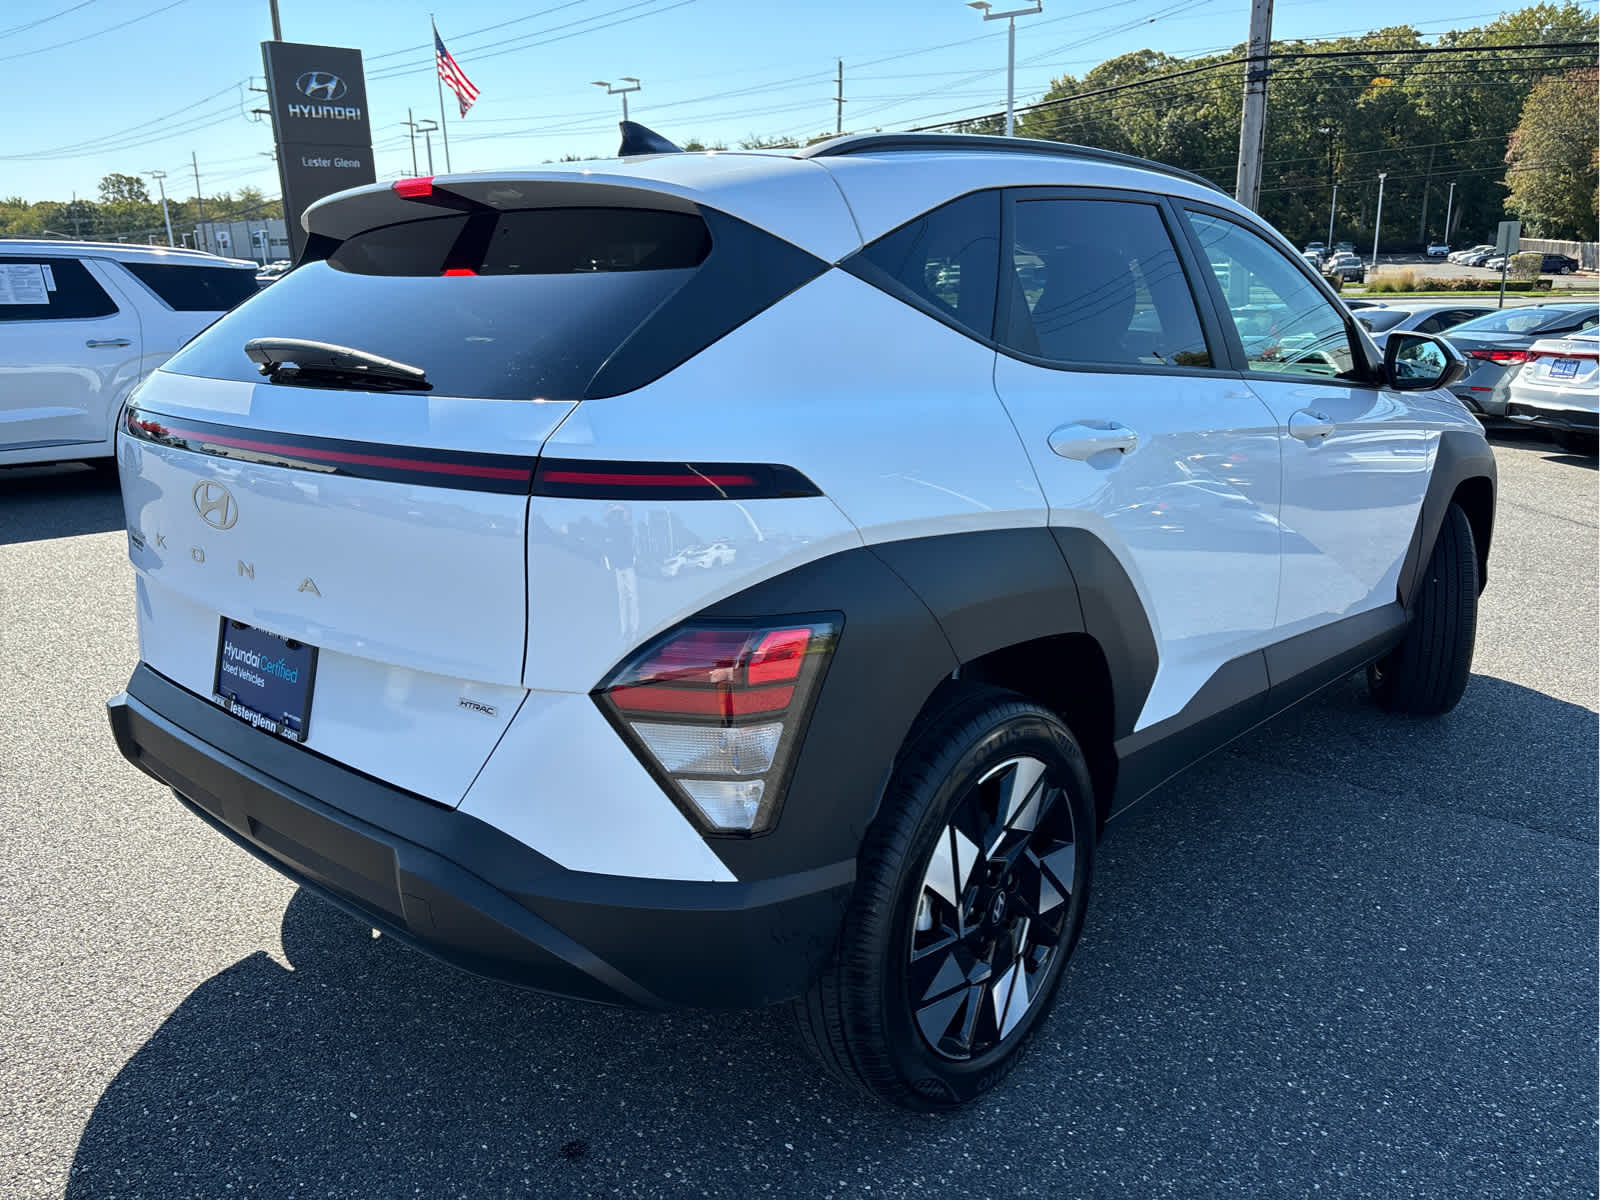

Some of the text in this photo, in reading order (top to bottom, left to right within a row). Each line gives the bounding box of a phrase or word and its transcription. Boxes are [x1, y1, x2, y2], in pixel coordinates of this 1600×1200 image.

[288, 103, 361, 120] HYUNDAI
[302, 157, 361, 168] Lester Glenn
[157, 533, 321, 597] KONA
[224, 640, 297, 683] Hyundai Certified
[223, 660, 265, 688] Used Vehicles
[460, 700, 495, 715] HTRAC
